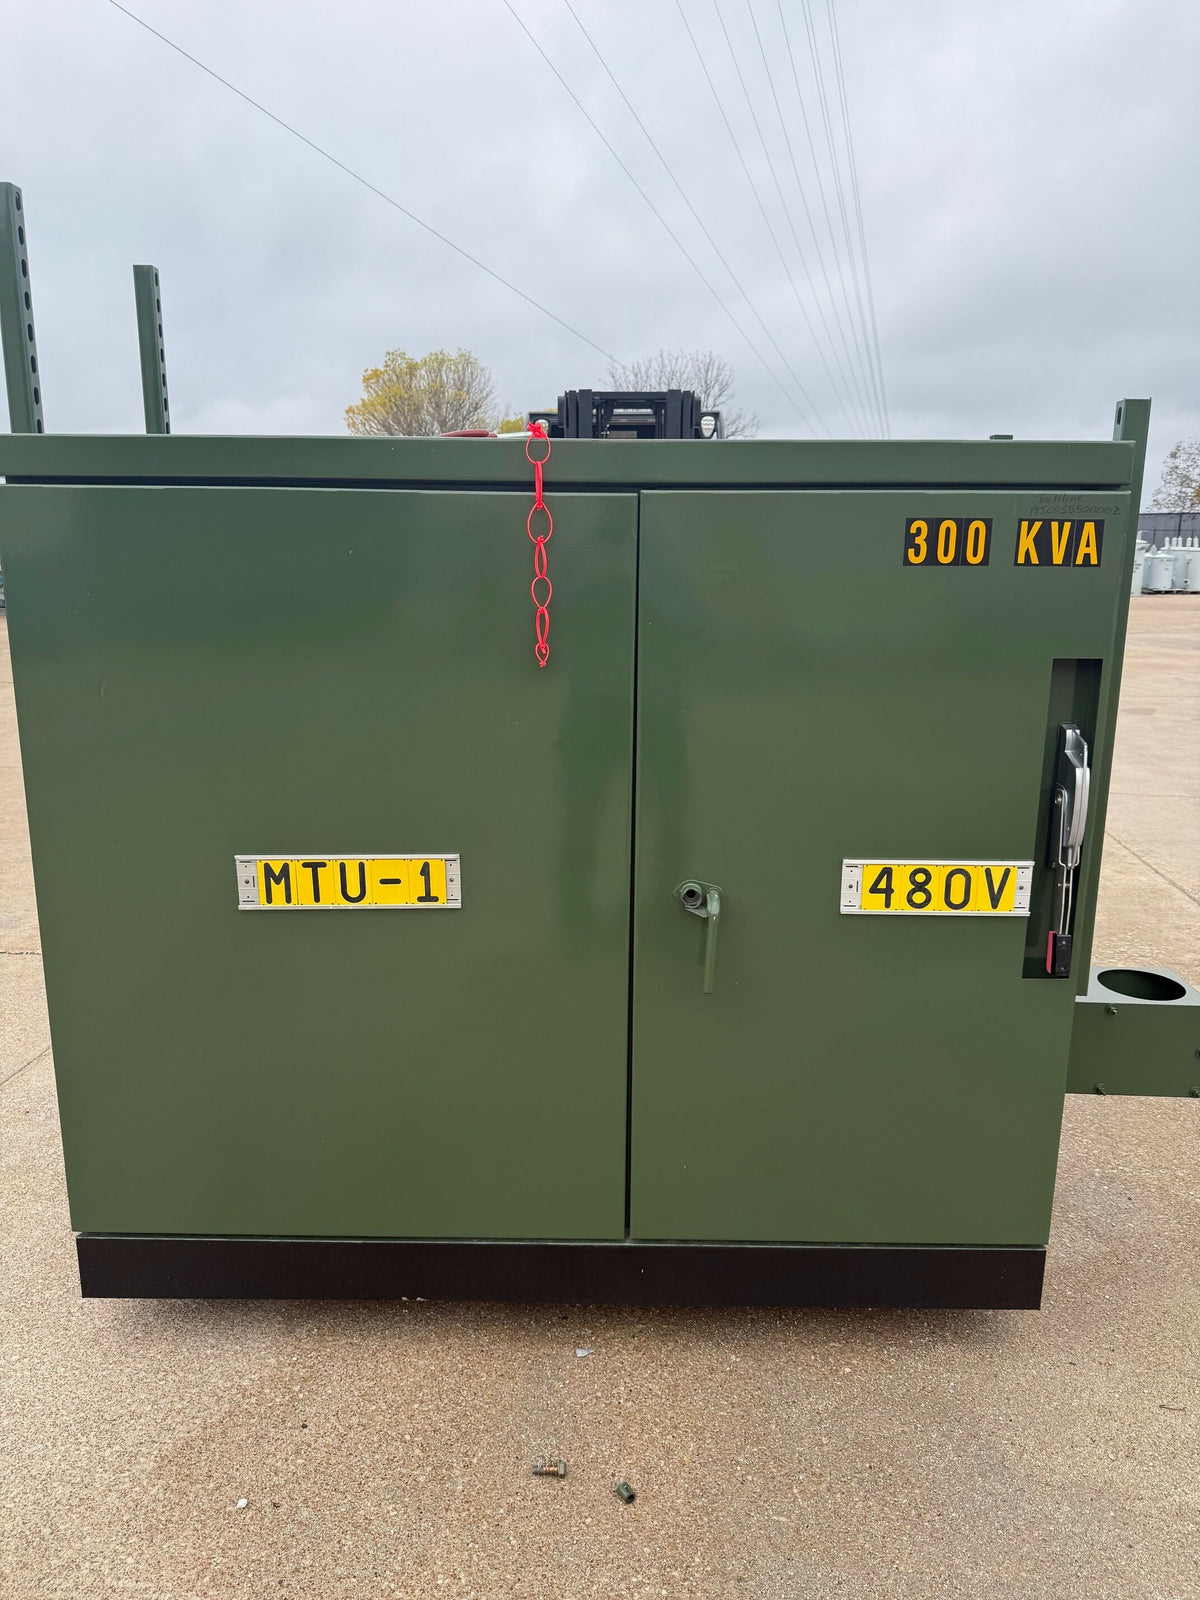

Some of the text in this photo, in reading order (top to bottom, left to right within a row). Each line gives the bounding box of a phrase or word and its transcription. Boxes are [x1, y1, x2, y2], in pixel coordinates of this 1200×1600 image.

[907, 519, 1099, 565] 300 KVA
[263, 861, 440, 904] MTU-1
[868, 866, 1011, 911] 480V
